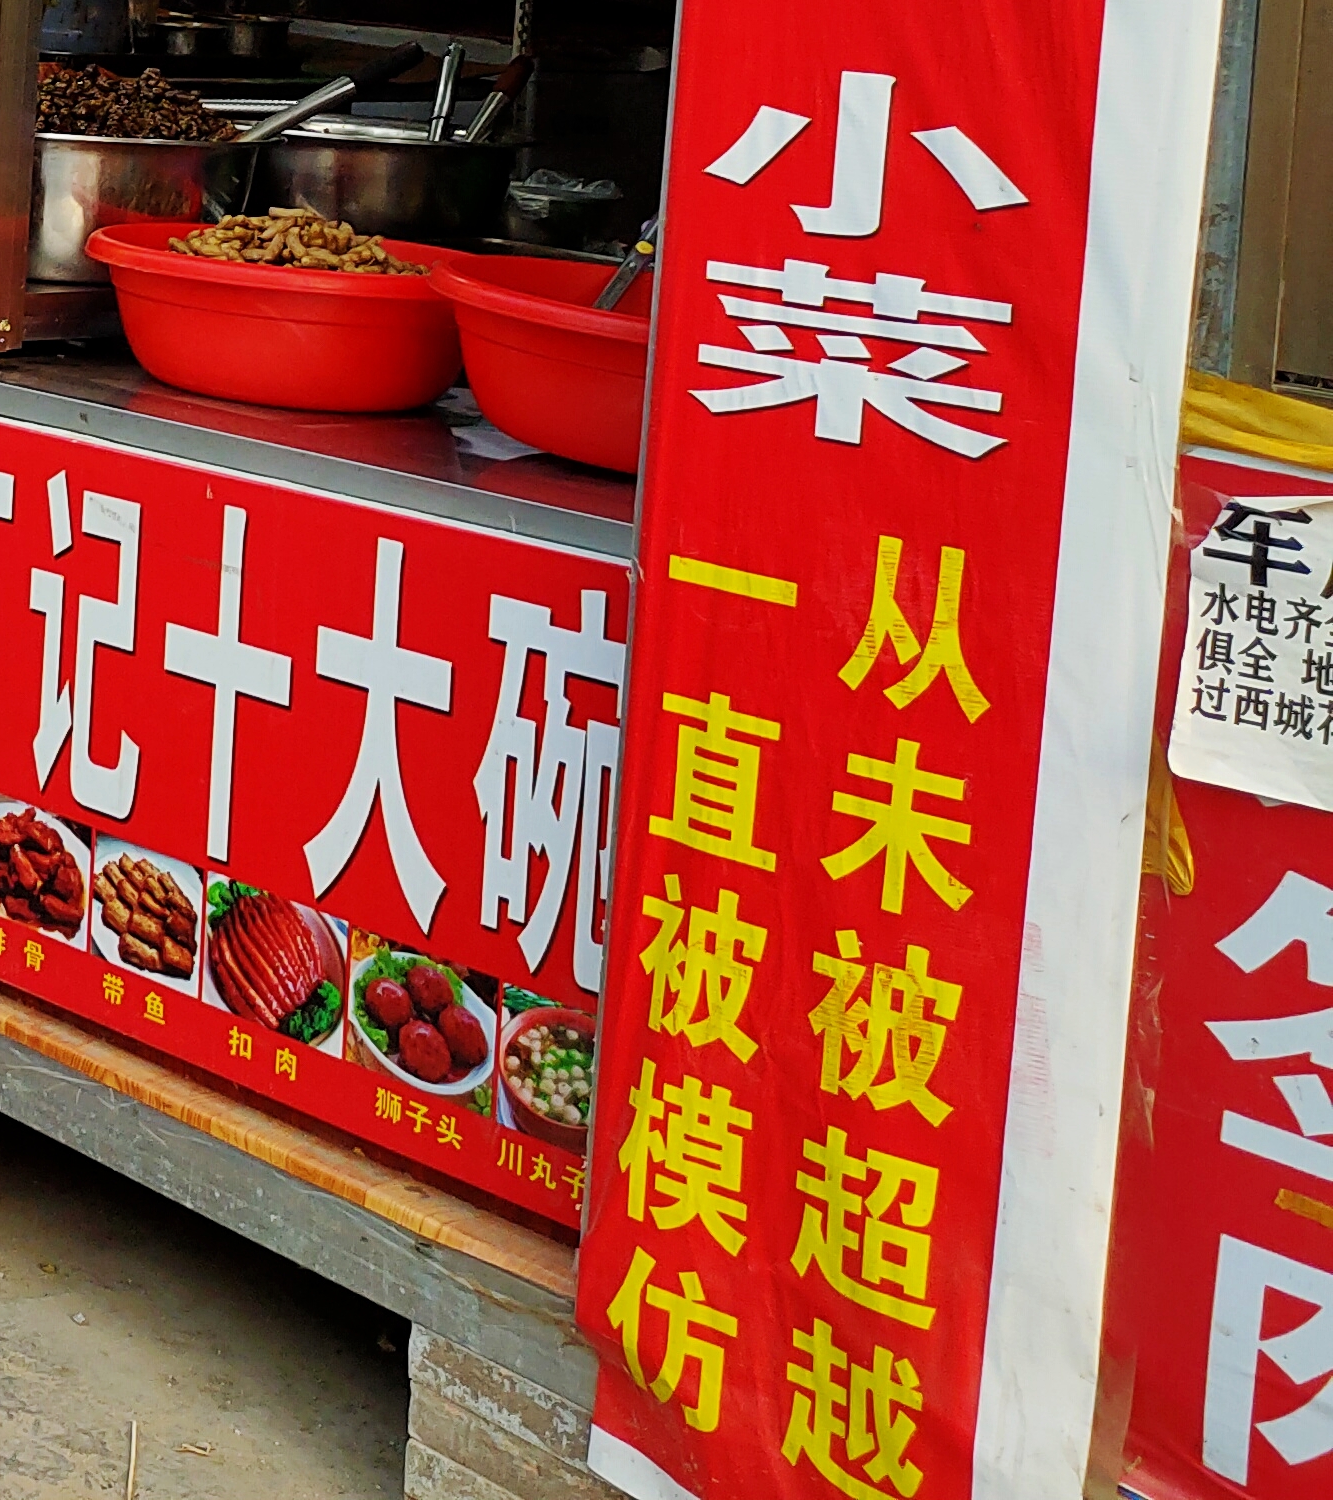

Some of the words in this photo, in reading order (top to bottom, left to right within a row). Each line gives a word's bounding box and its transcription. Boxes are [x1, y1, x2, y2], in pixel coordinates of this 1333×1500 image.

[689, 70, 1032, 456] 小菜
[1195, 627, 1278, 683] 俱全
[102, 973, 167, 1028] 带鱼
[607, 554, 799, 1432] 一直被模仿
[783, 535, 992, 1500] 从未被超越
[228, 1025, 299, 1083] 扣肉
[373, 1085, 465, 1152] 狮子头
